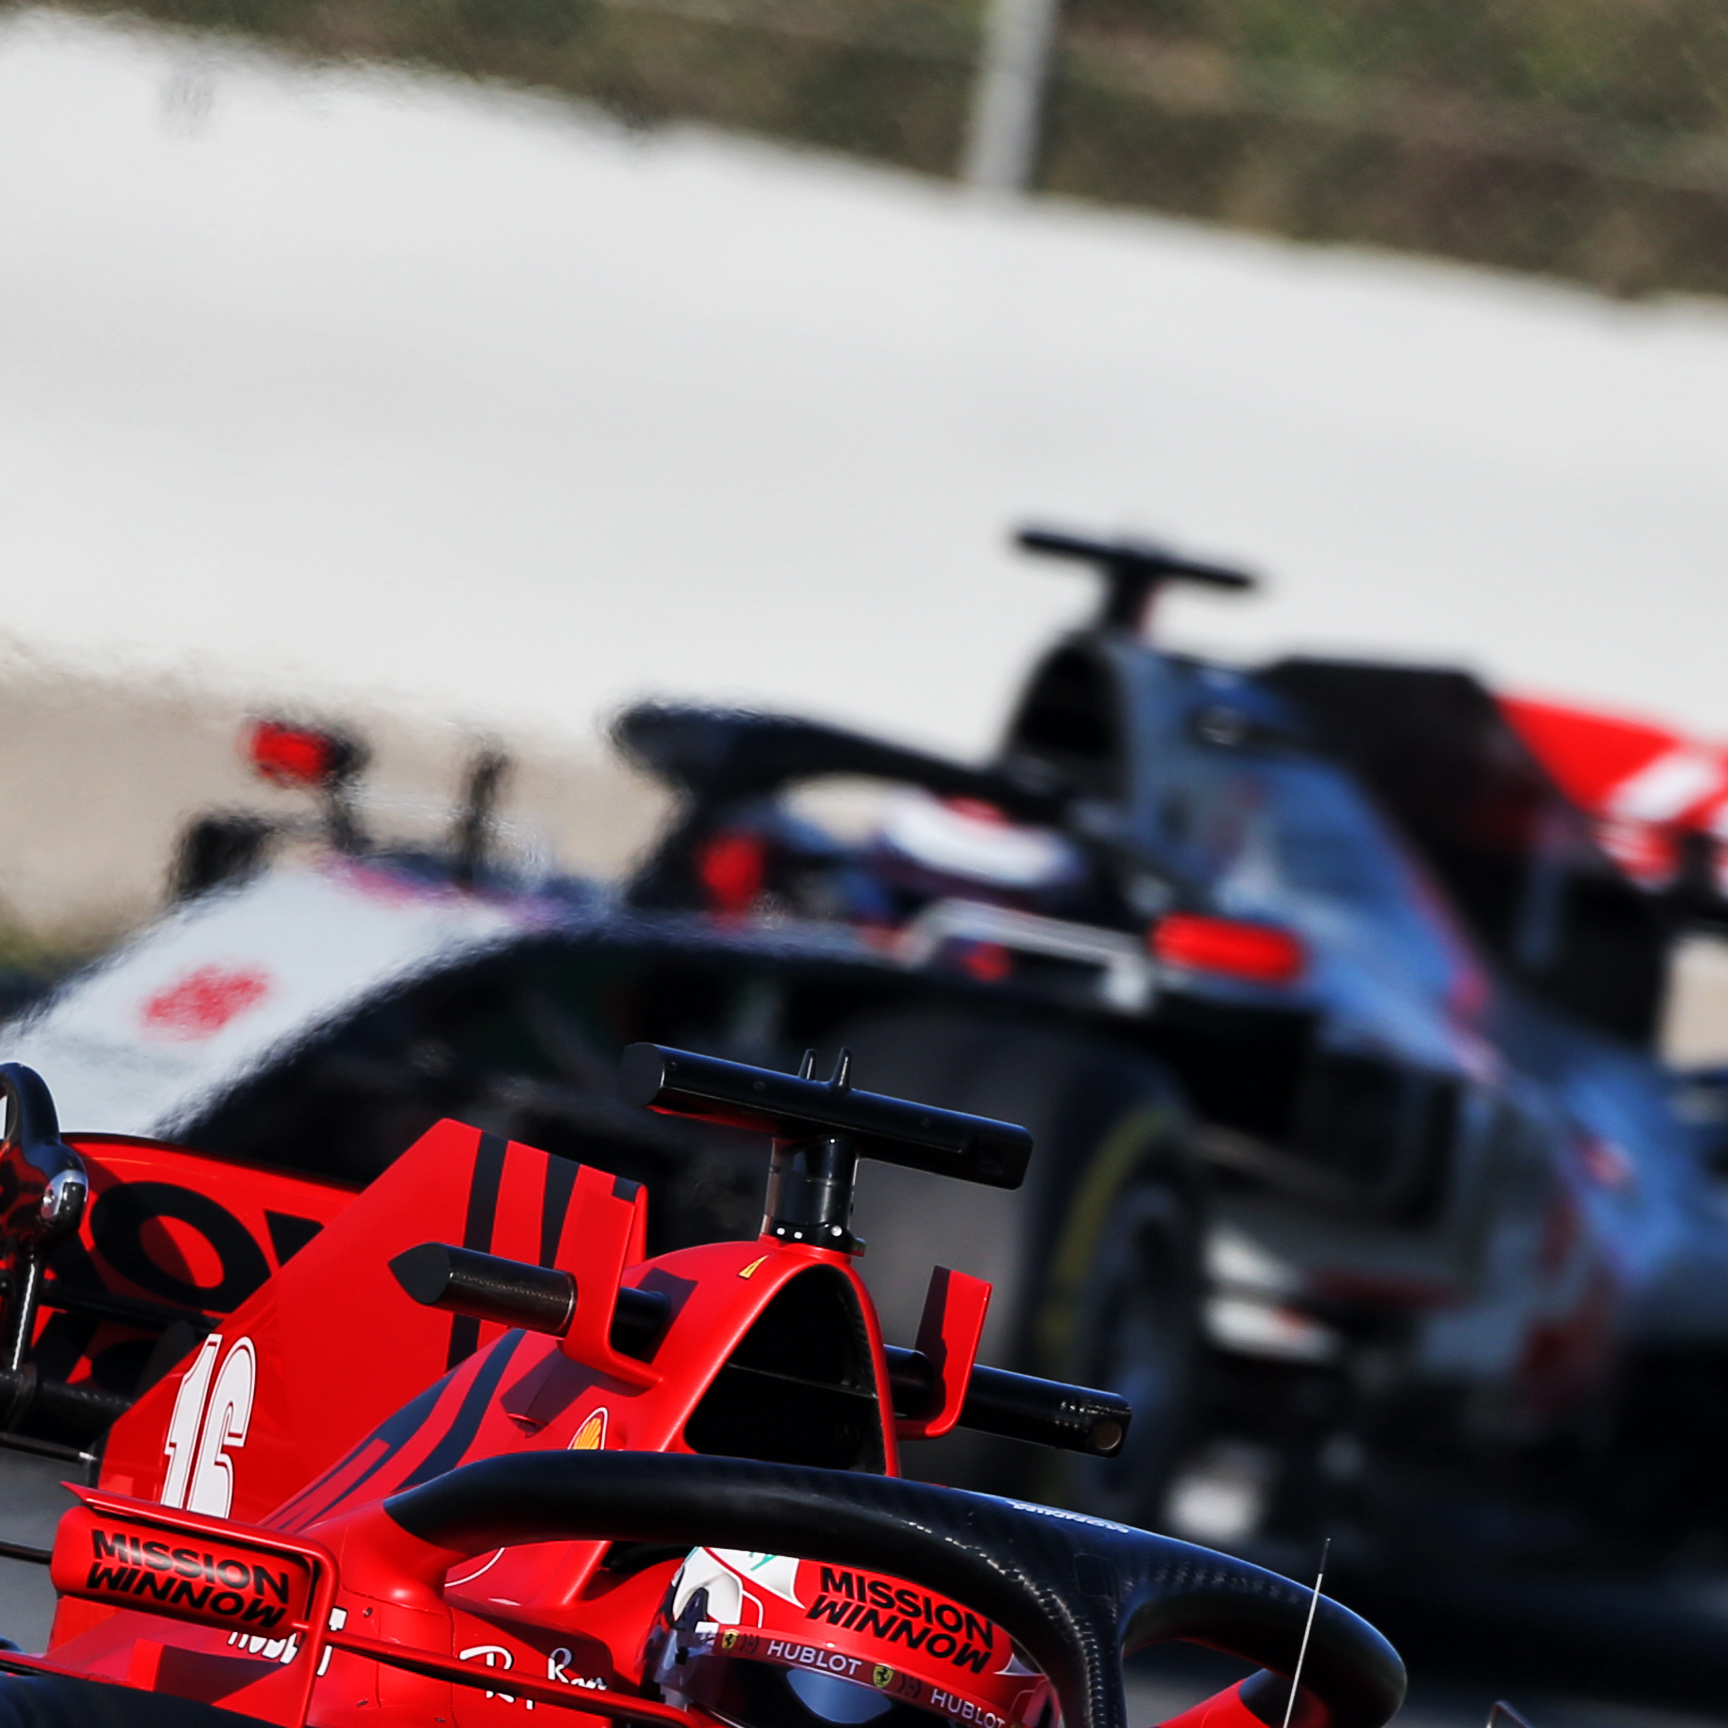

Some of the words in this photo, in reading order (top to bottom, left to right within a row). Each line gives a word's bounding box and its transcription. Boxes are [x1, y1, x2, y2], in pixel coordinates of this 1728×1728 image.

[162, 1333, 257, 1519] 16
[86, 1561, 287, 1628] WINNOW
[91, 1529, 289, 1602] MISSION
[805, 1594, 993, 1675] WINNOW
[819, 1565, 994, 1649] MISSION
[766, 1641, 863, 1676] HUBLOT
